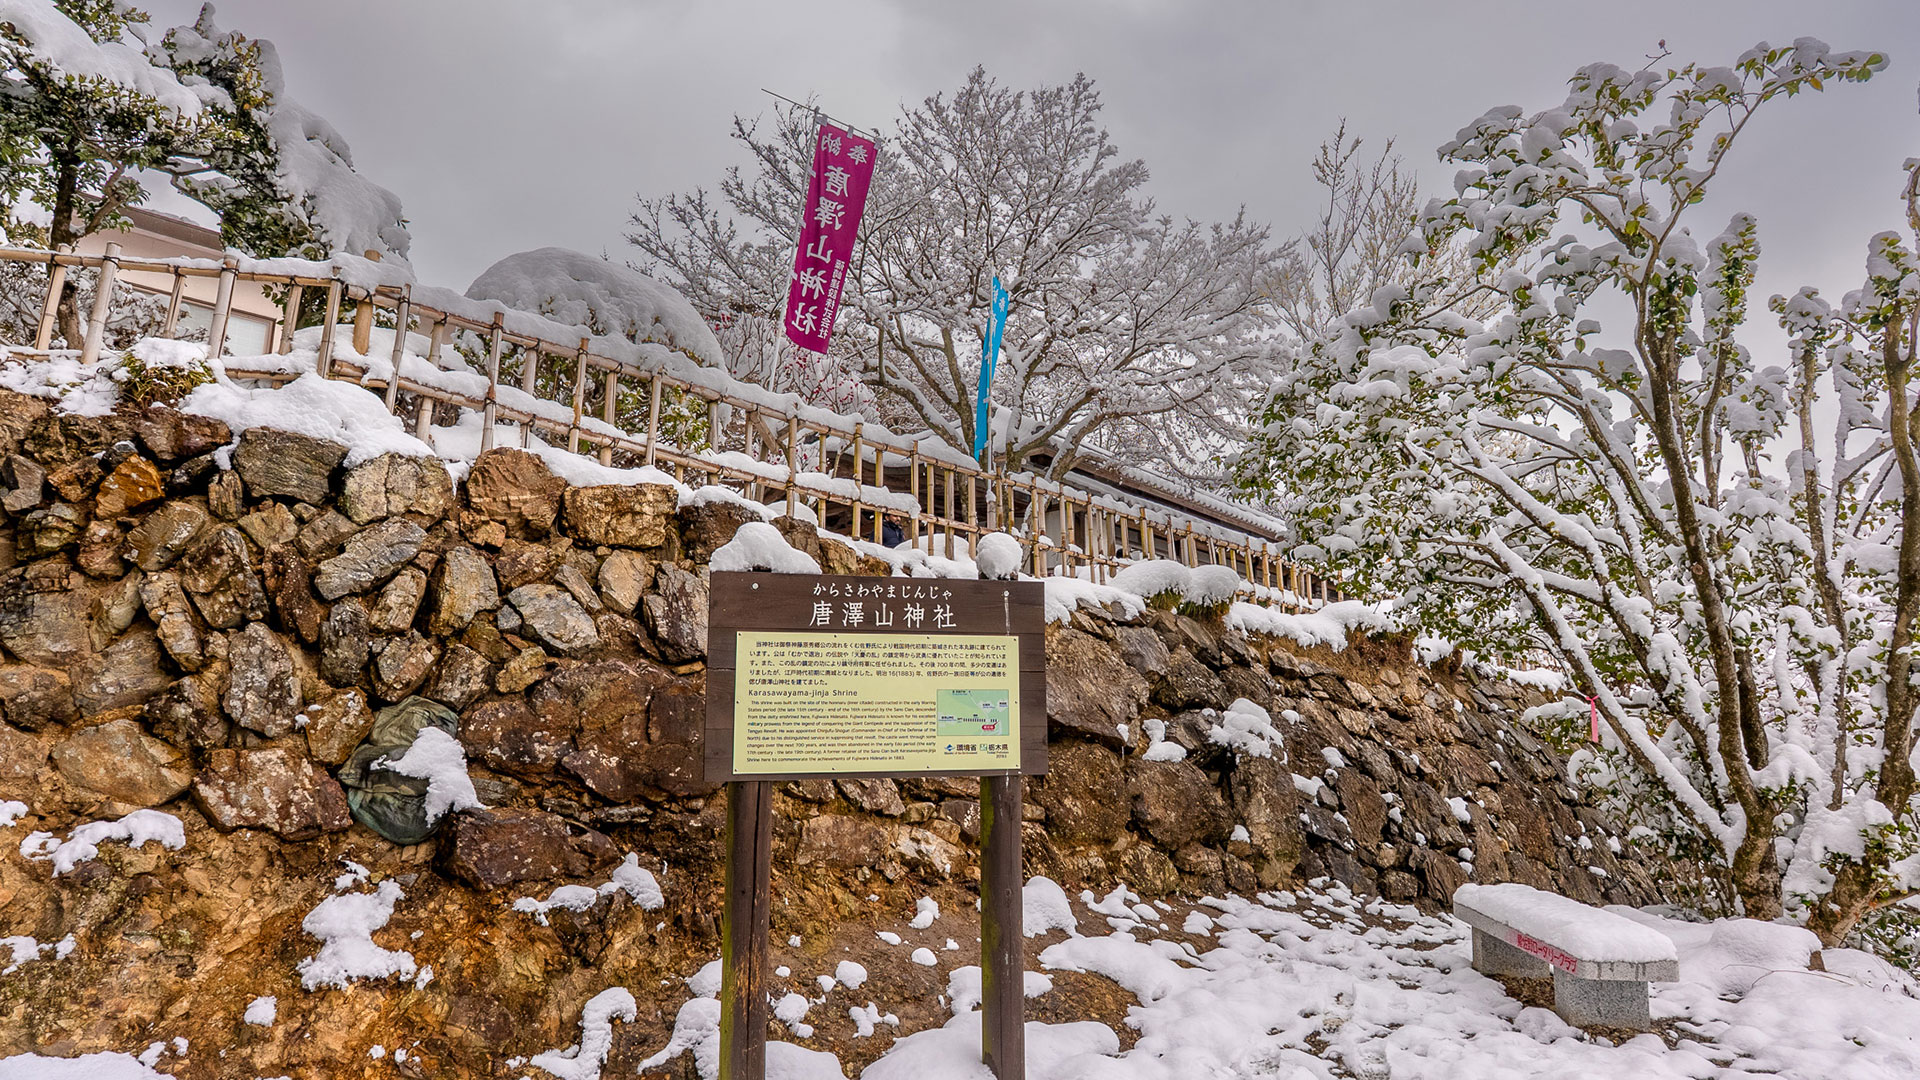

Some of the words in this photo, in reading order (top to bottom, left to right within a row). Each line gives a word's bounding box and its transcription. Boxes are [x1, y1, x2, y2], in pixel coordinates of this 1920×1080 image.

[813, 582, 952, 600] からさわやまじんじゃ
[808, 600, 956, 628] 唐澤山神社
[749, 690, 829, 698] Karasawayama-jinja
